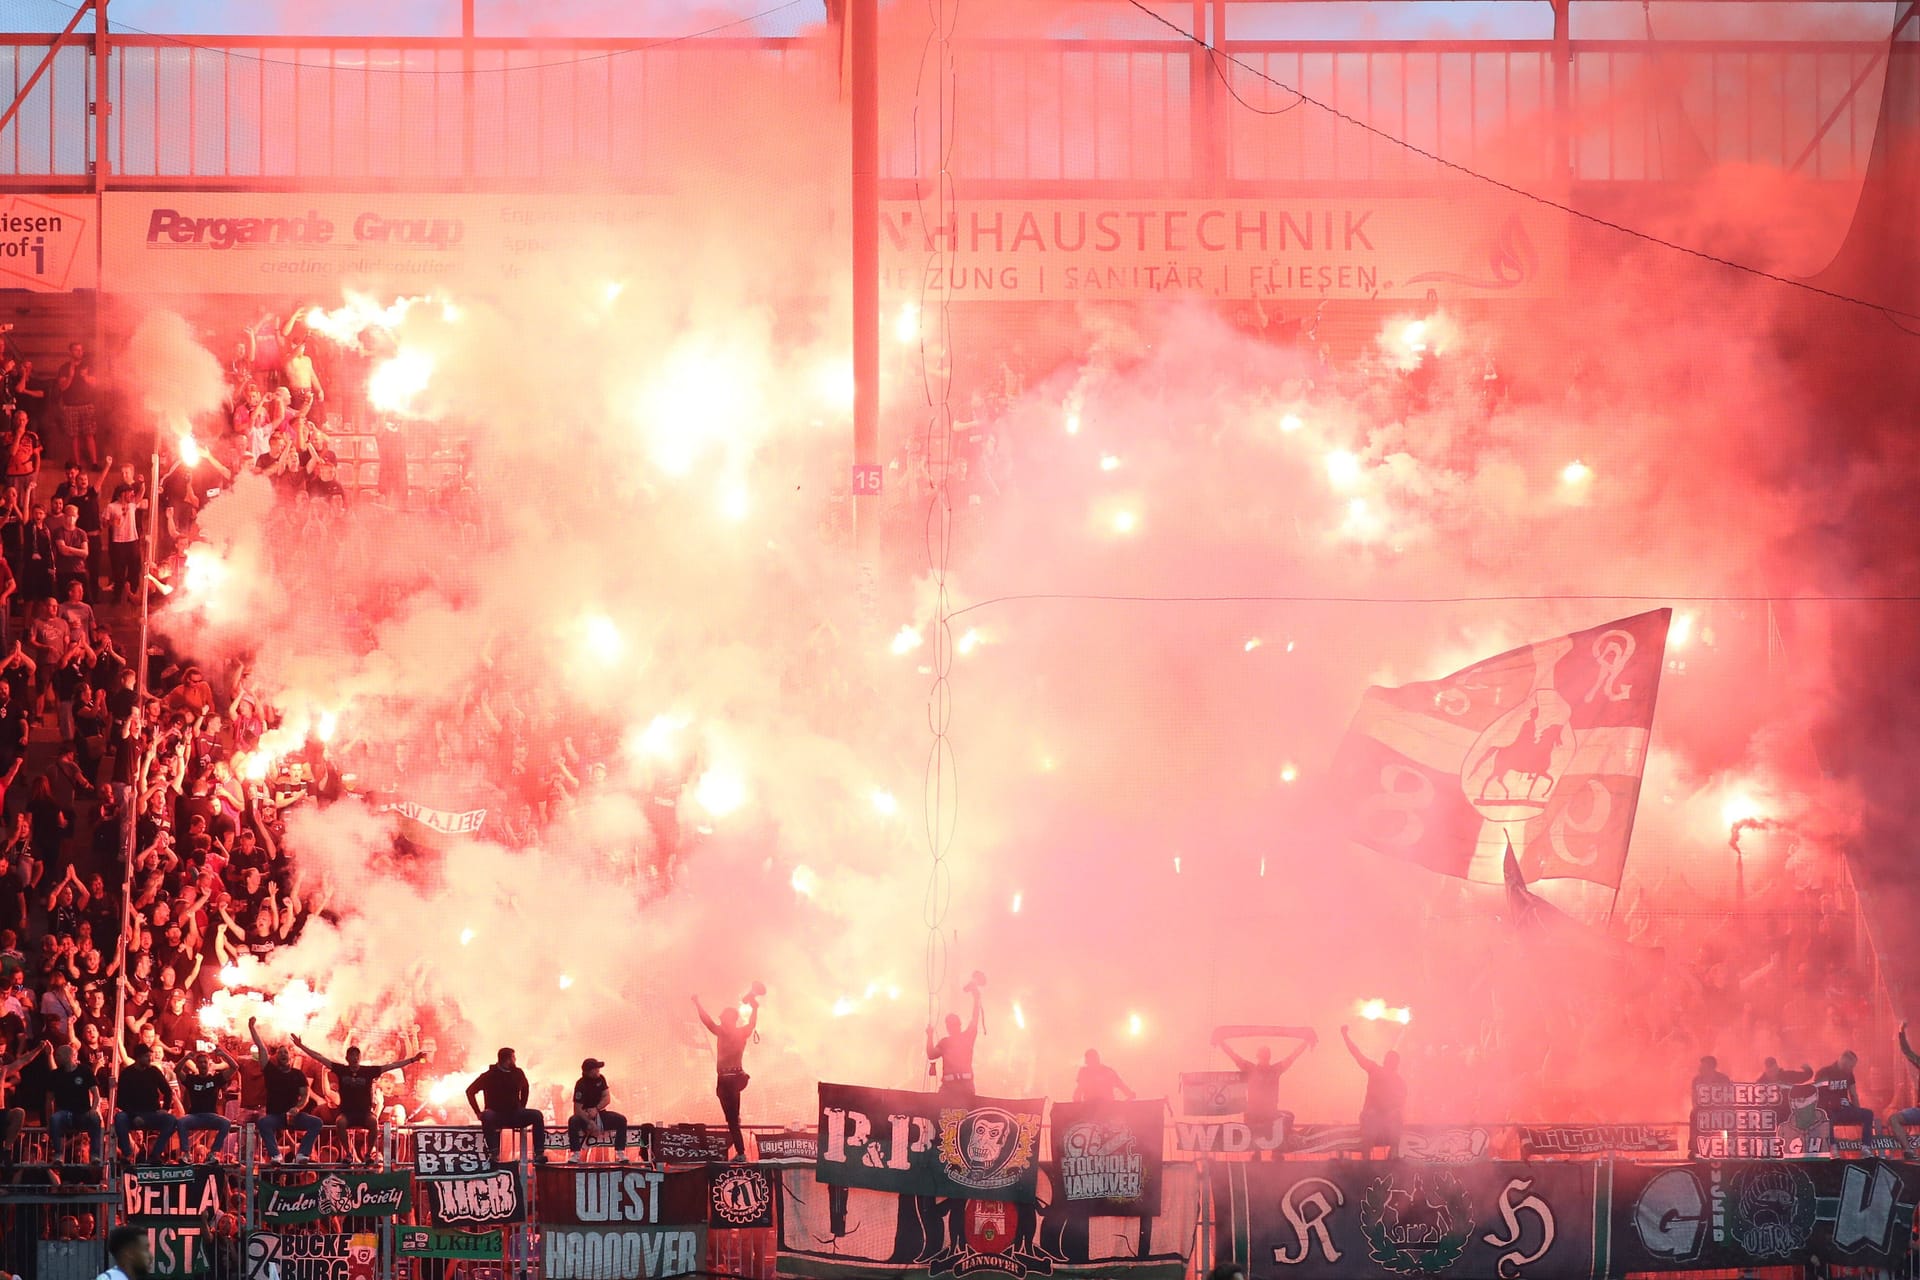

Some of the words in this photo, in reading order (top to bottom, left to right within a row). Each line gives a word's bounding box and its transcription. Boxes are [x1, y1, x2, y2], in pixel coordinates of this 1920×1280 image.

[0, 213, 62, 232] iesen
[147, 209, 334, 250] Pergande
[353, 212, 464, 250] Group
[856, 471, 880, 489] 15
[1697, 1138, 1784, 1157] VEREINE
[162, 1169, 194, 1179] kurve
[1063, 1173, 1139, 1197] HANNOVER
[124, 1173, 220, 1215] BELLA
[264, 1190, 316, 1217] Linder
[352, 1182, 404, 1210] Society
[575, 1171, 665, 1223] WEST
[545, 1231, 697, 1280] HANNOVER
[961, 1256, 1020, 1274] HANNOVER
